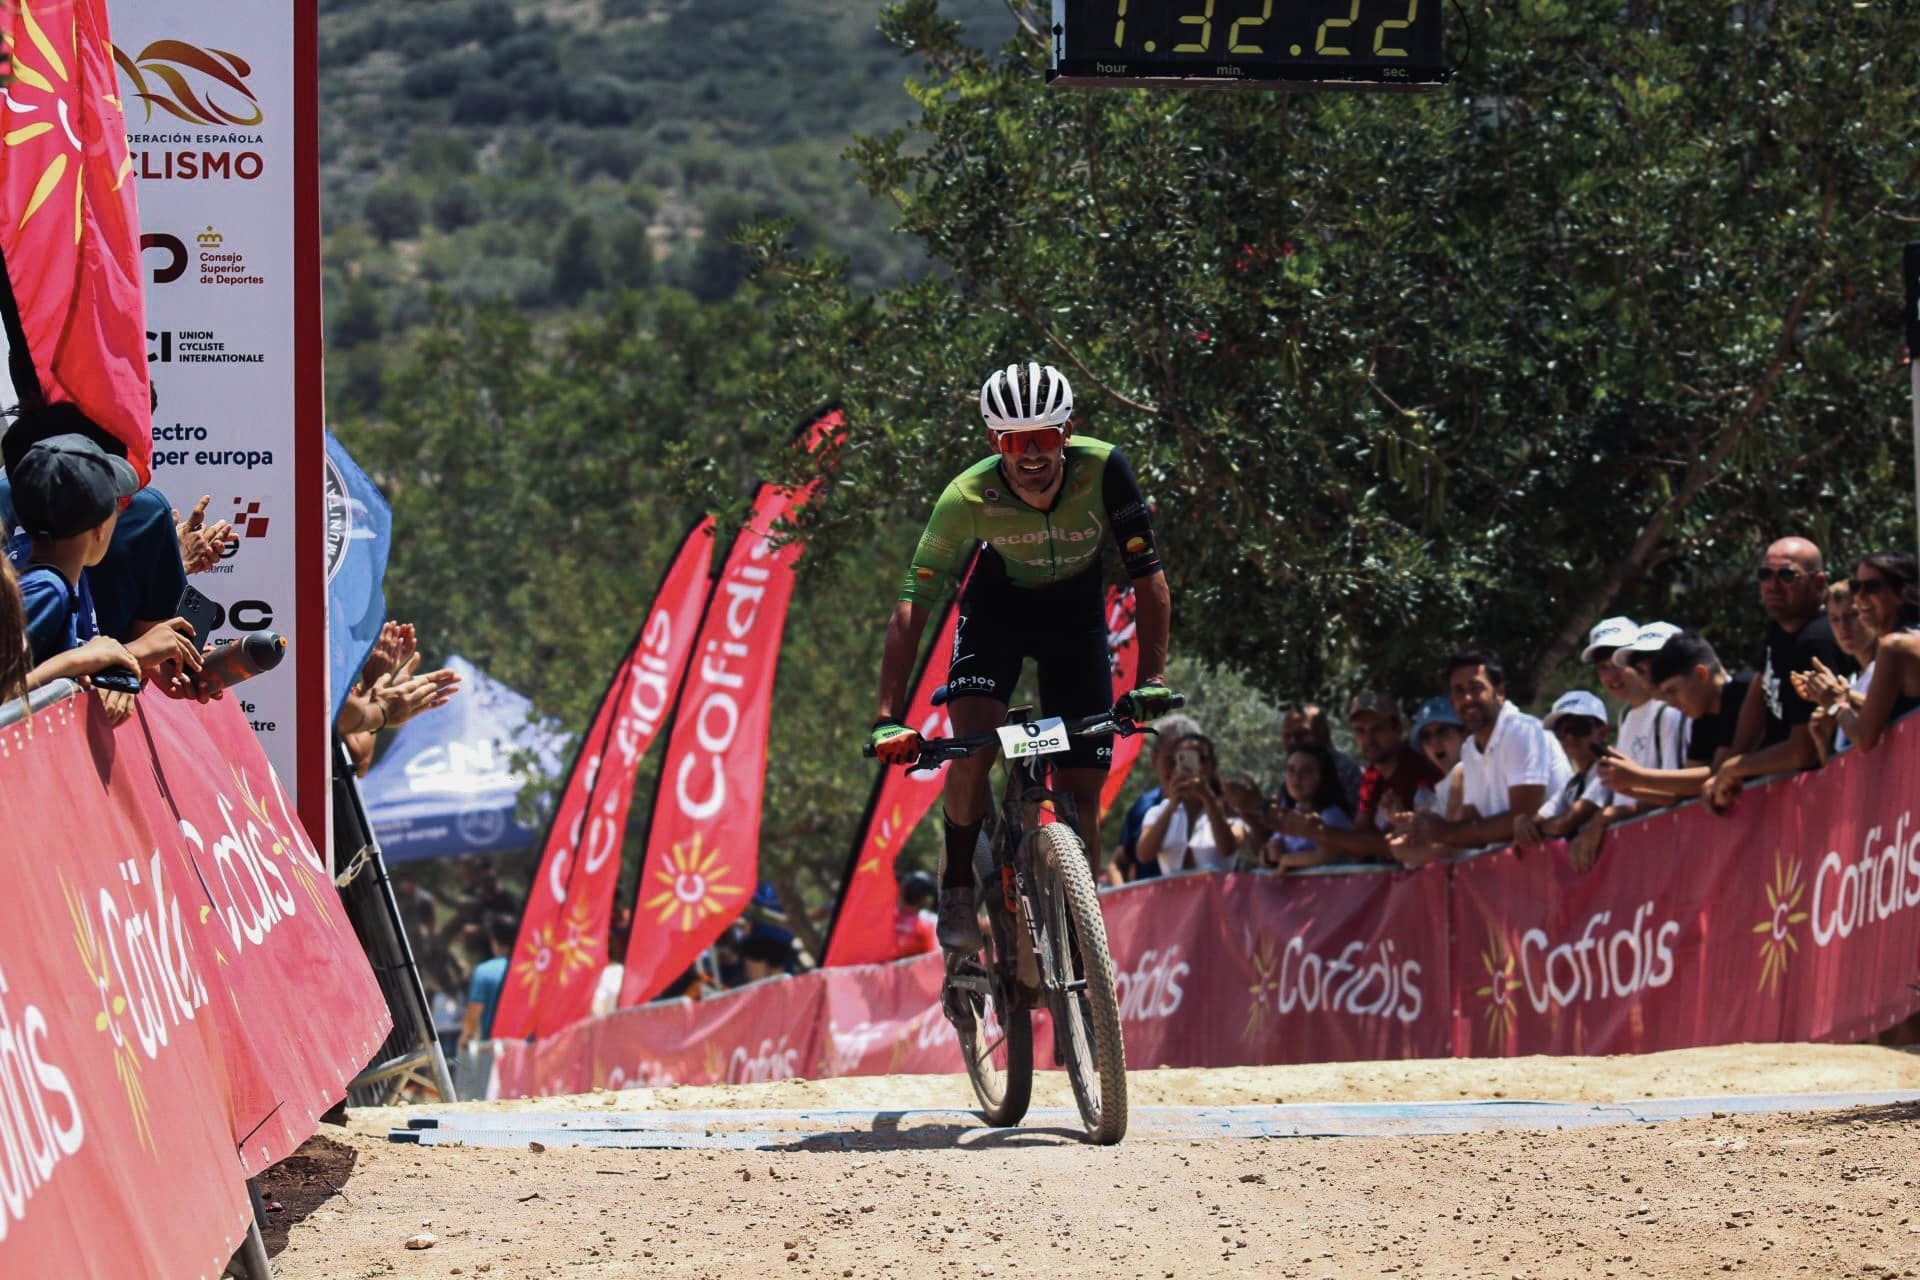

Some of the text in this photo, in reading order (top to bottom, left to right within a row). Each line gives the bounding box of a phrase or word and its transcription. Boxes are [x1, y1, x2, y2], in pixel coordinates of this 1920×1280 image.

[1096, 62, 1409, 78] hour min. sec.
[196, 133, 264, 143] ESPAÑOLA
[200, 252, 242, 263] Consejo
[200, 263, 246, 274] Superior
[200, 275, 264, 286] de Deportes
[179, 331, 214, 340] UNION
[179, 342, 225, 351] CYCLISTE
[179, 354, 265, 363] INTERNATIONALE
[152, 423, 207, 441] ectro
[152, 450, 273, 470] per europa
[992, 526, 1097, 545] ecopilas
[1028, 738, 1060, 749] CDC
[1520, 901, 1681, 1014] Cofidis
[1278, 936, 1423, 1022] Cofidis
